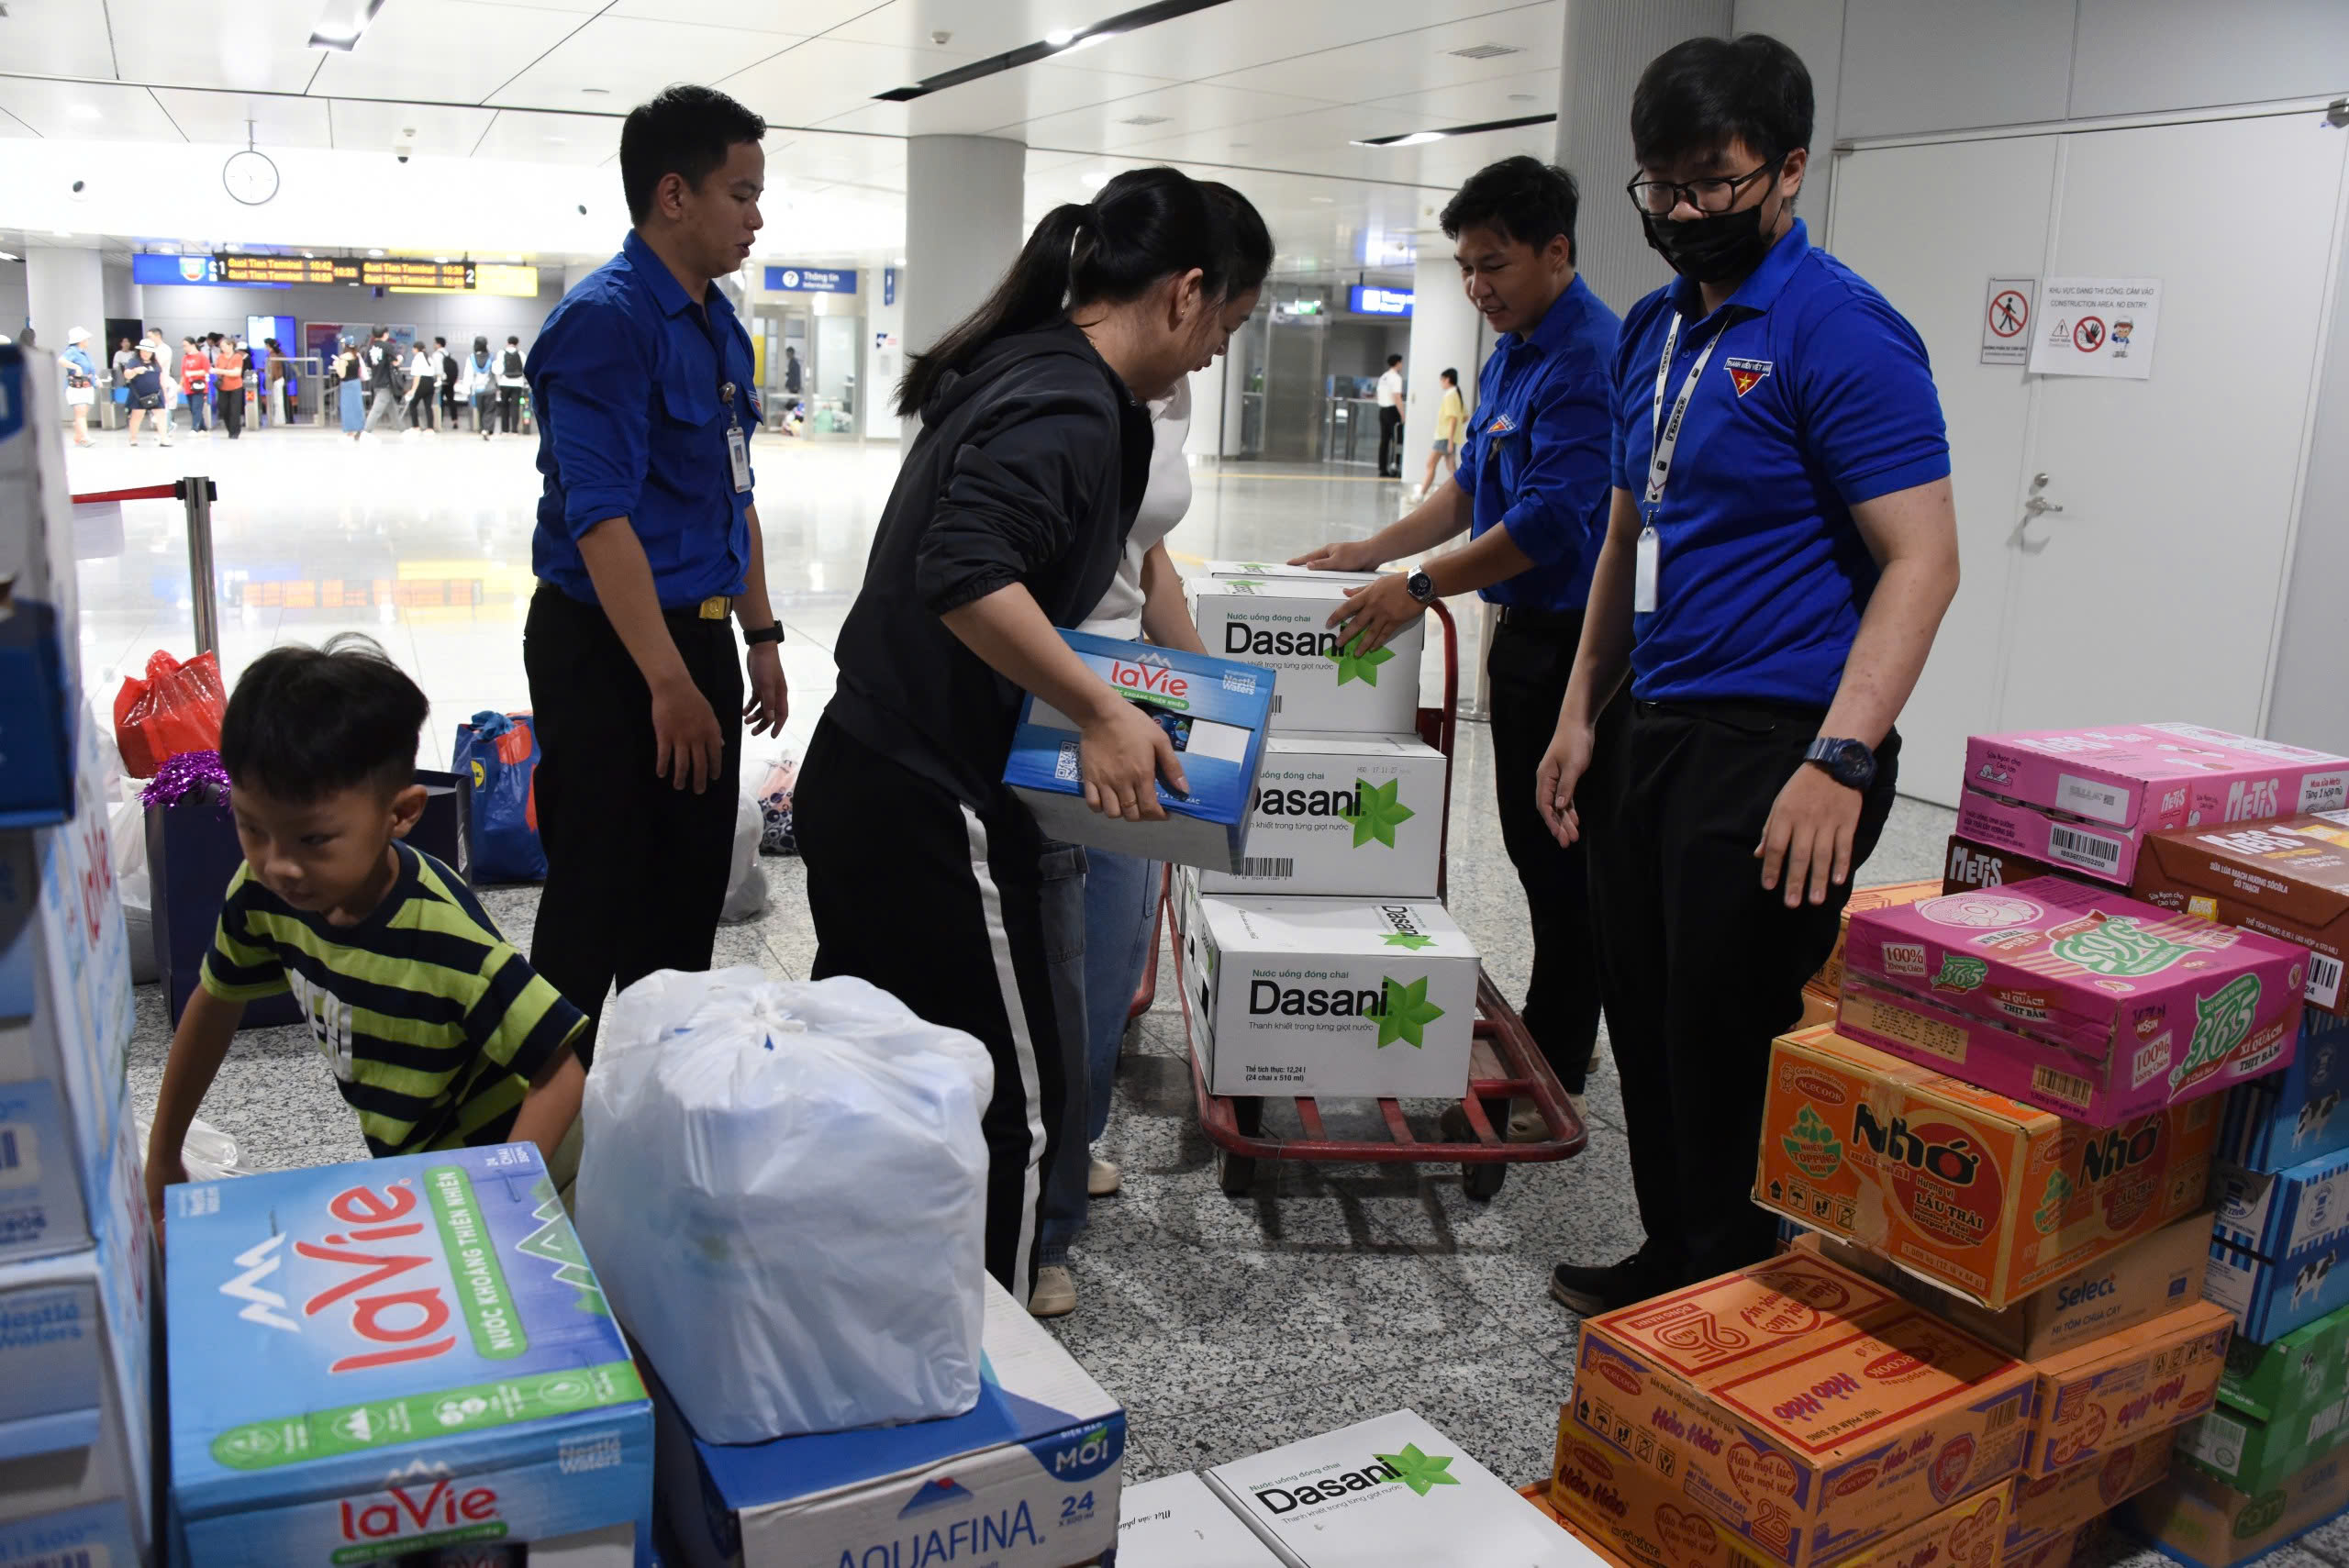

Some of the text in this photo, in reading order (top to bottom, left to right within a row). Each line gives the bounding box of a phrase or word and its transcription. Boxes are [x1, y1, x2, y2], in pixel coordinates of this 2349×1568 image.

[218, 261, 226, 274] 1
[268, 259, 304, 269] Terminal
[268, 271, 304, 282] Terminal
[402, 263, 436, 274] Terminal
[402, 275, 437, 285] Terminal
[465, 270, 475, 284] 2
[2050, 300, 2097, 308] CONSTRUCTION
[1227, 612, 1248, 620] Nước
[1250, 613, 1270, 622] uống
[1272, 614, 1292, 623] đóng
[1260, 771, 1324, 781] uống đóng chai
[1275, 822, 1294, 831] trong
[2174, 892, 2184, 900] cho
[1886, 947, 1923, 964] 100%
[1252, 969, 1349, 979] Nước uống đóng chai
[1942, 963, 1984, 988] 365
[1250, 980, 1388, 1017] Dasani
[1249, 1021, 1273, 1030] Thanh
[1275, 1021, 1293, 1030] khiết
[1295, 1023, 1314, 1032] trong
[1316, 1023, 1334, 1032] từng
[1336, 1023, 1351, 1032] giọt
[2184, 989, 2256, 1073] 365
[2136, 1037, 2169, 1072] 100%
[1245, 1073, 1256, 1082] (24
[1850, 1103, 1982, 1186] Nhớ
[1792, 1151, 1837, 1164] TOPPING
[435, 1171, 466, 1207] NHIÊN
[1917, 1174, 1955, 1202] Hương vị
[447, 1207, 479, 1247] THIÊN
[1946, 1205, 1984, 1229] THÁI
[1913, 1212, 1982, 1248] Hotpot Flavour
[462, 1247, 500, 1307] KHOÁNG
[2055, 1277, 2116, 1312] Select
[480, 1307, 516, 1351] NƯỚC
[2064, 1318, 2081, 1330] TÔM
[2082, 1310, 2105, 1325] CHUA
[2106, 1304, 2122, 1318] CAY
[1773, 1372, 1862, 1422] Hảo Hảo
[1652, 1406, 1721, 1456] Hảo Hảo
[1806, 1428, 1828, 1441] SUNG
[1249, 1462, 1341, 1492] Nước uống đóng chai
[1254, 1456, 1403, 1514] Dasani
[1061, 1490, 1095, 1518] 24
[1281, 1485, 1403, 1524] Thanh khiết trong từng giọt nước
[1753, 1498, 1792, 1545] 25
